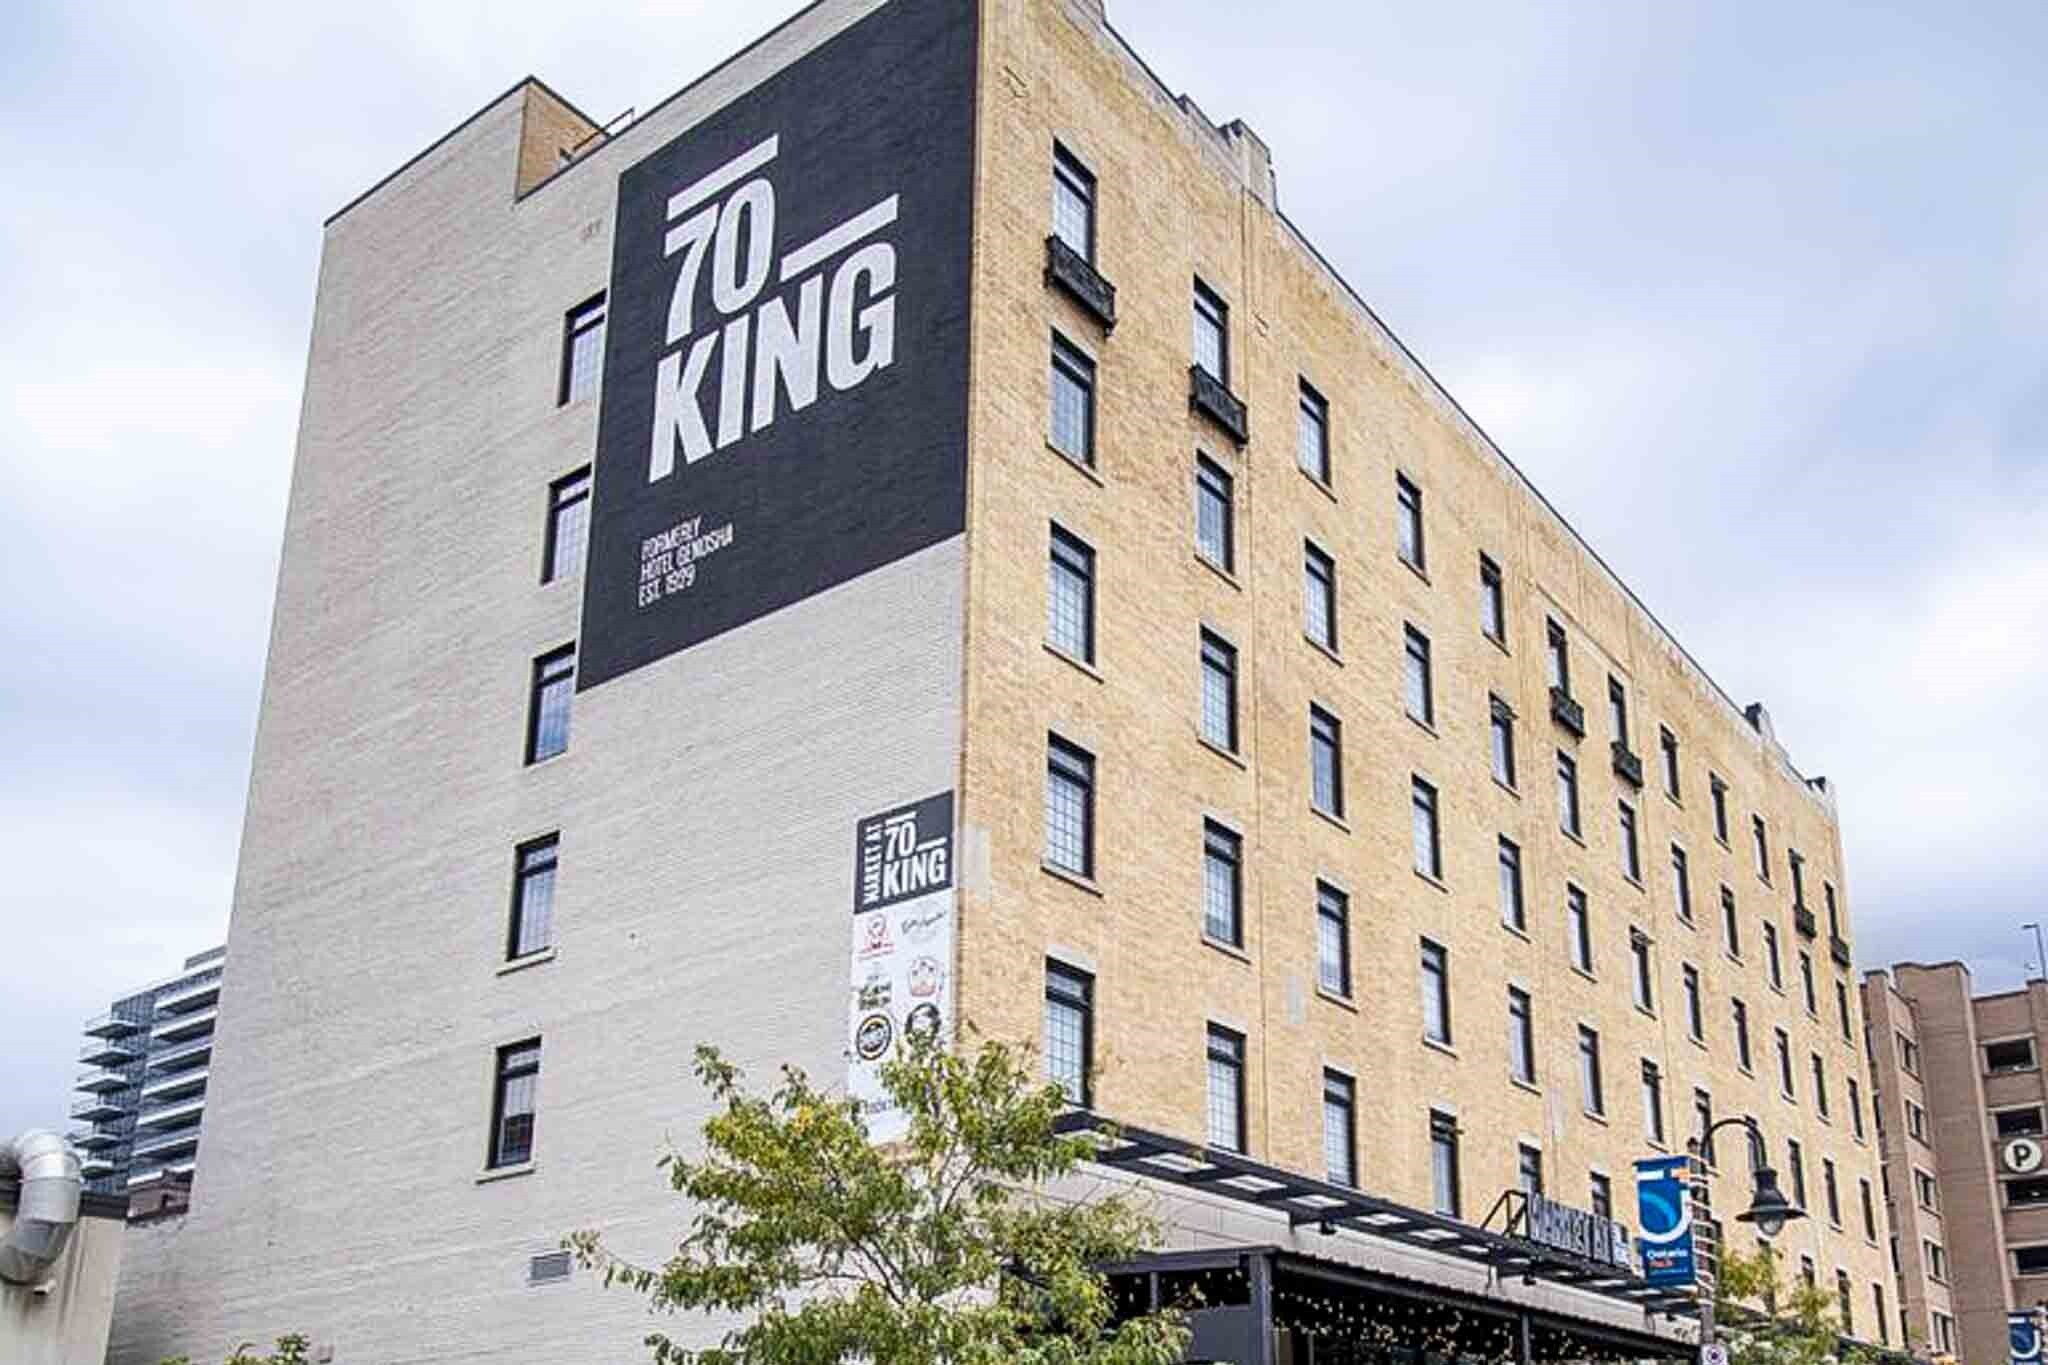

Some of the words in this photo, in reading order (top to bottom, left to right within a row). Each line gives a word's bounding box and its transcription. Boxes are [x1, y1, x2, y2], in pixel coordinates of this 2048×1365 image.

[665, 177, 776, 347] 70
[649, 241, 898, 484] KING
[639, 554, 673, 584] HOTEL
[884, 821, 916, 862] 70
[883, 848, 946, 899] KING
[2013, 1143, 2031, 1167] P
